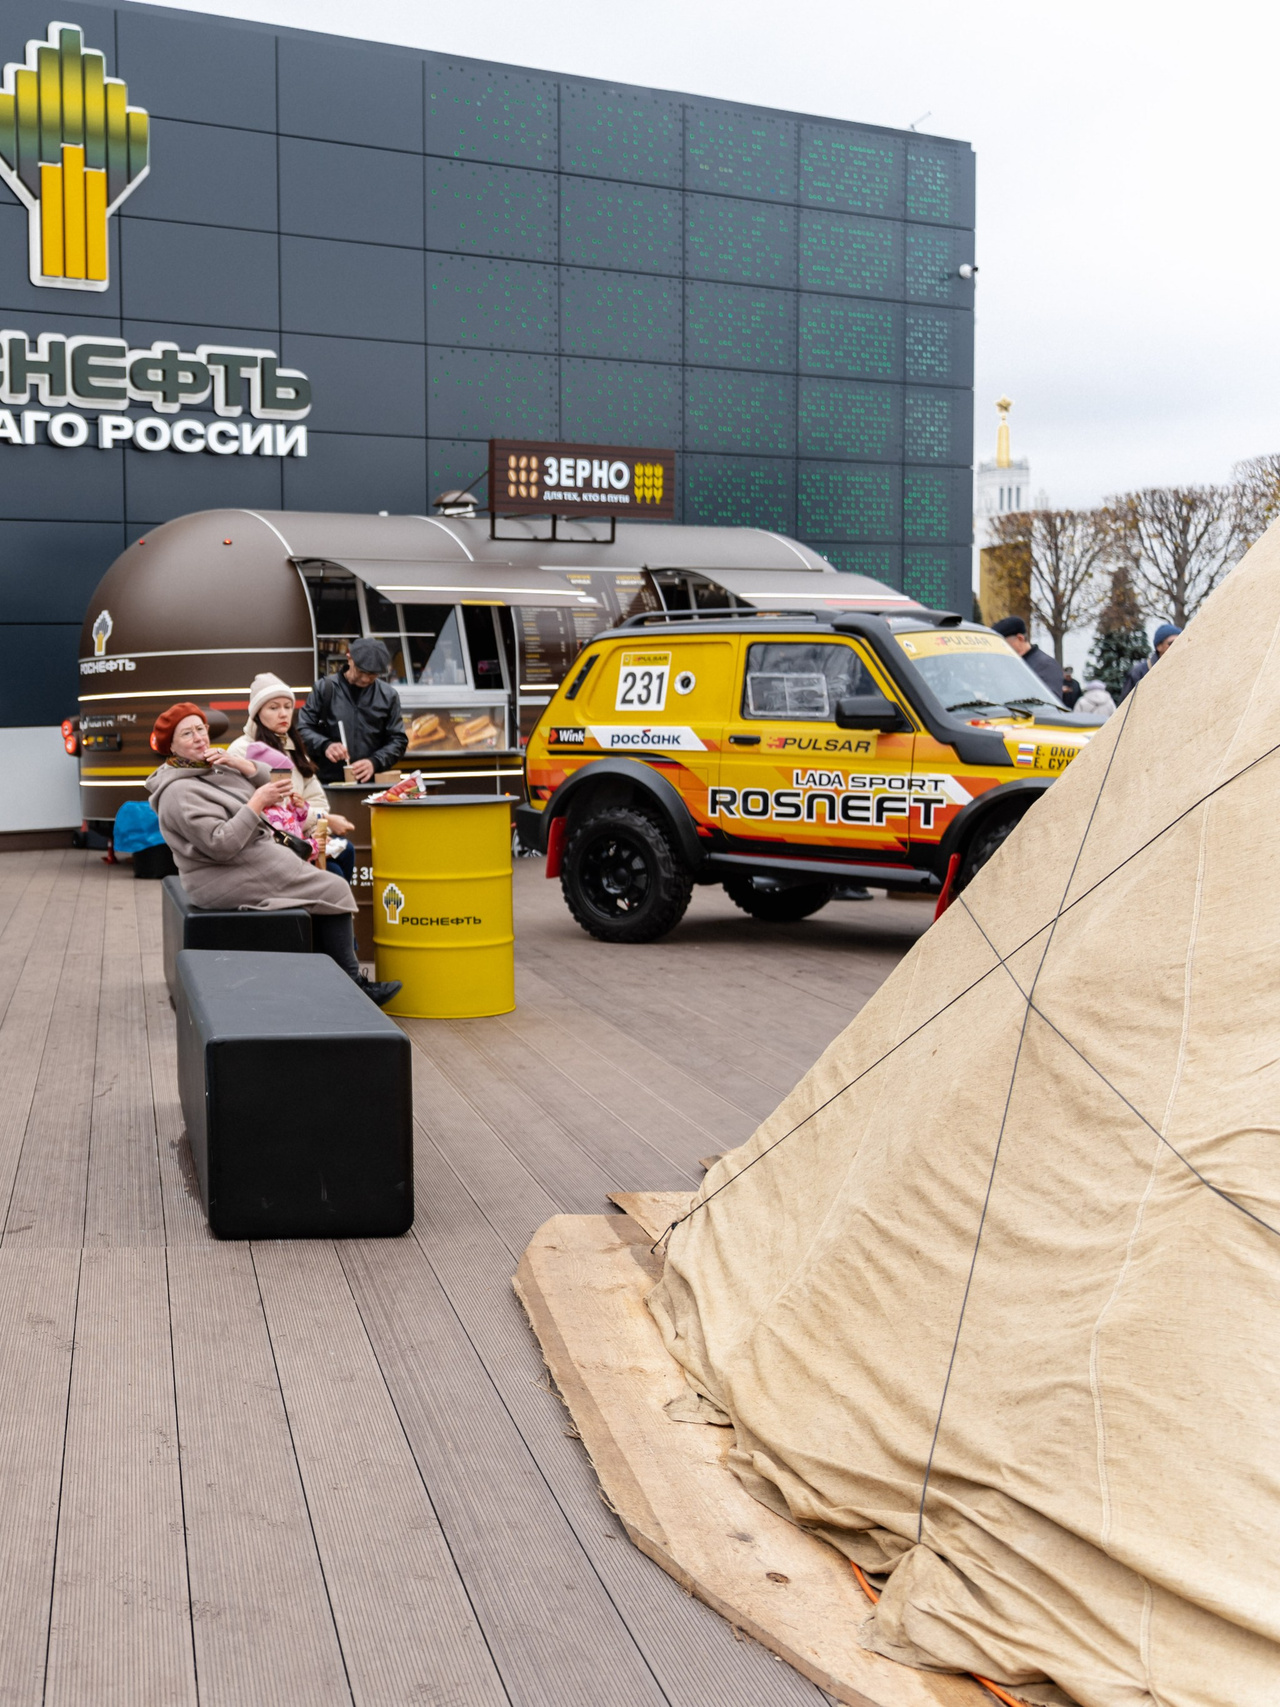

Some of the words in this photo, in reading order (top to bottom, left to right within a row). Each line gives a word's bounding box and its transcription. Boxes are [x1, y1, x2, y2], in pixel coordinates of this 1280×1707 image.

[98, 415, 308, 457] РОССИИ
[543, 456, 631, 490] ЗЕРНО
[543, 490, 563, 501] ДЛЯ
[582, 492, 599, 502] КТО
[600, 493, 607, 502] В
[607, 494, 630, 504] ПУТИ
[944, 634, 990, 647] PULSAR
[80, 659, 137, 675] РОСНЕФТЬ
[620, 671, 665, 705] 231
[559, 729, 585, 742] Wink
[611, 729, 681, 747] росбанк
[782, 737, 871, 753] PULSAR
[795, 772, 843, 788] LADA
[851, 776, 946, 792] SPORT
[401, 916, 482, 926] РОСНЕФТЬ
